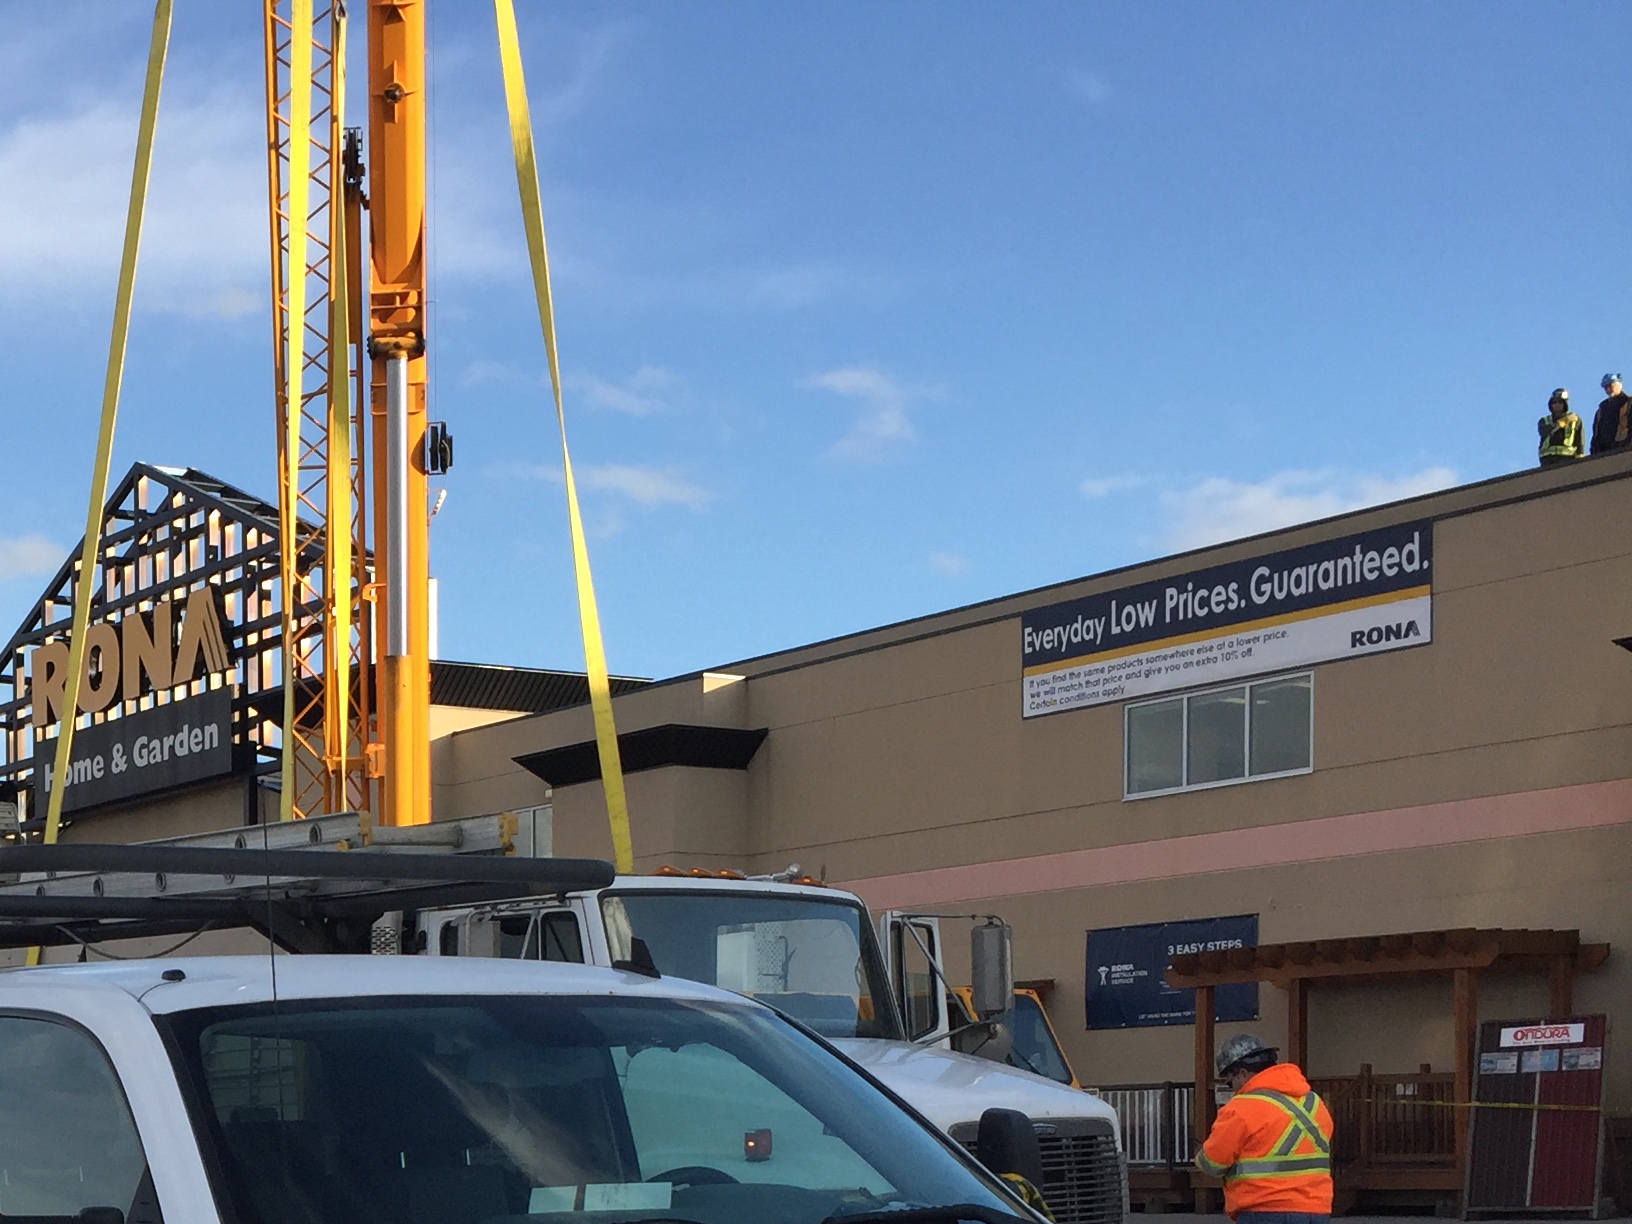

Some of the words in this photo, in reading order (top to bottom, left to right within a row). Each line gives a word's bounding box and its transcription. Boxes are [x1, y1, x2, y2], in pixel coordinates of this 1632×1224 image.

[1024, 614, 1106, 654] Everyday
[1111, 599, 1157, 635] Low
[1165, 581, 1246, 624] Prices.
[1250, 531, 1430, 605] Guaranteed.
[31, 585, 230, 728] RONA
[1036, 678, 1051, 688] you
[1052, 672, 1067, 684] find
[1068, 671, 1081, 681] the
[1083, 666, 1106, 678] same
[1108, 657, 1144, 672] products
[1145, 649, 1195, 665] somewhere
[1196, 644, 1214, 655] else
[1216, 641, 1226, 651] at
[1236, 635, 1261, 647] lower
[1263, 629, 1290, 644] price.
[1351, 620, 1421, 649] RONA
[1029, 690, 1041, 699] we
[1043, 686, 1056, 697] will
[1057, 681, 1084, 694] match
[1085, 677, 1101, 689] that
[1102, 673, 1123, 688] price
[1125, 669, 1142, 681] and
[1144, 666, 1163, 679] give
[1164, 662, 1181, 674] you
[1183, 660, 1195, 670] an
[1196, 655, 1218, 667] extra
[1221, 650, 1239, 662] 10%
[1029, 698, 1058, 711] Certain
[1059, 690, 1100, 704] conditions
[1102, 685, 1126, 698] apply
[111, 743, 128, 774] &
[133, 721, 219, 768] Garden
[1167, 944, 1175, 956] 3
[1176, 942, 1206, 955] EASY
[1206, 938, 1243, 952] STEPS
